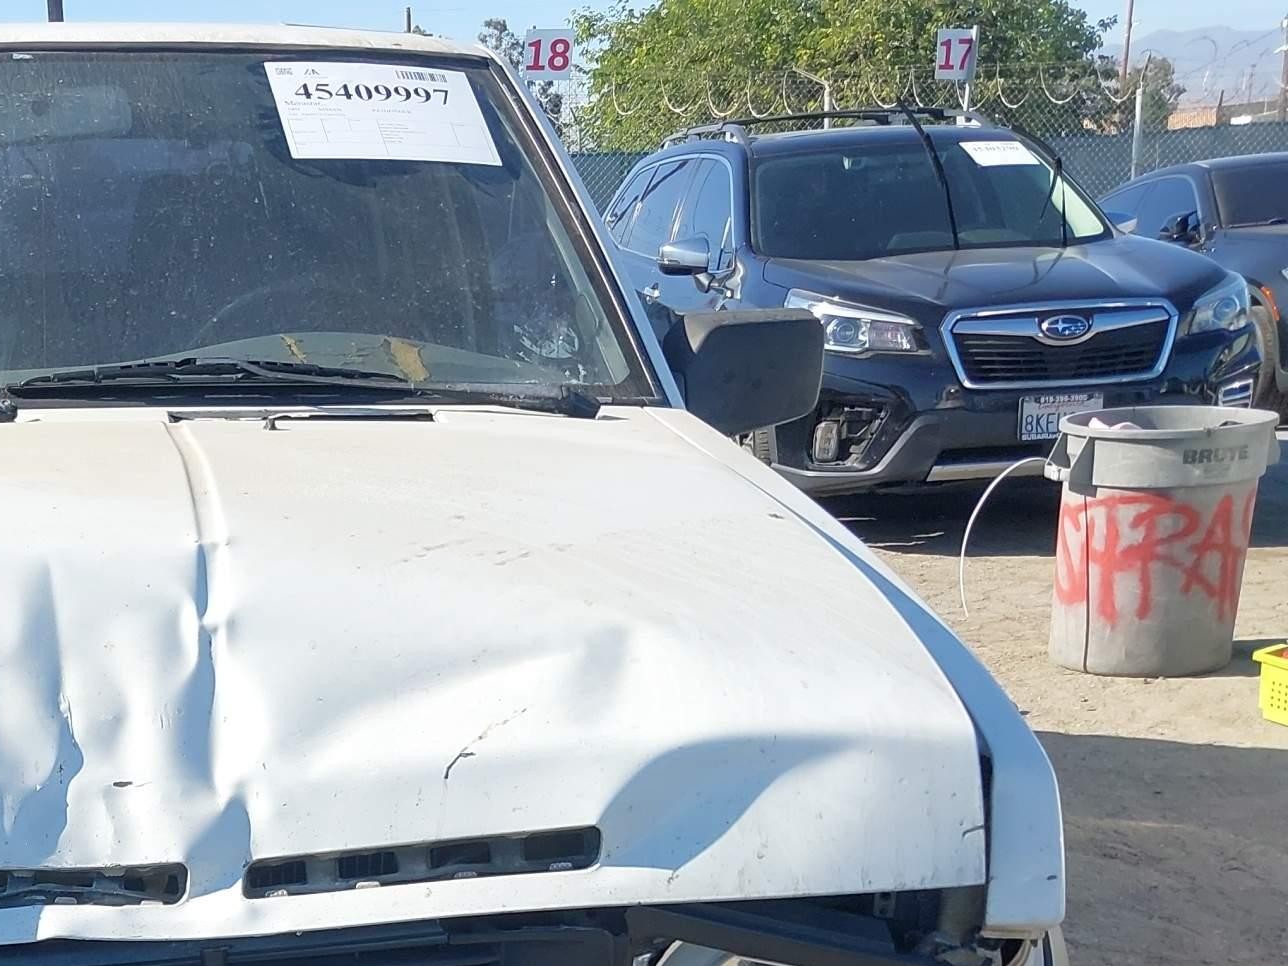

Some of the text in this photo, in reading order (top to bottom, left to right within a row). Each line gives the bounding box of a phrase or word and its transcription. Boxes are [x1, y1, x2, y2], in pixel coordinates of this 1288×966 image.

[525, 38, 570, 71] 18
[938, 38, 973, 70] 17
[294, 82, 449, 106] 45409997
[1182, 444, 1249, 465] BRUTE
